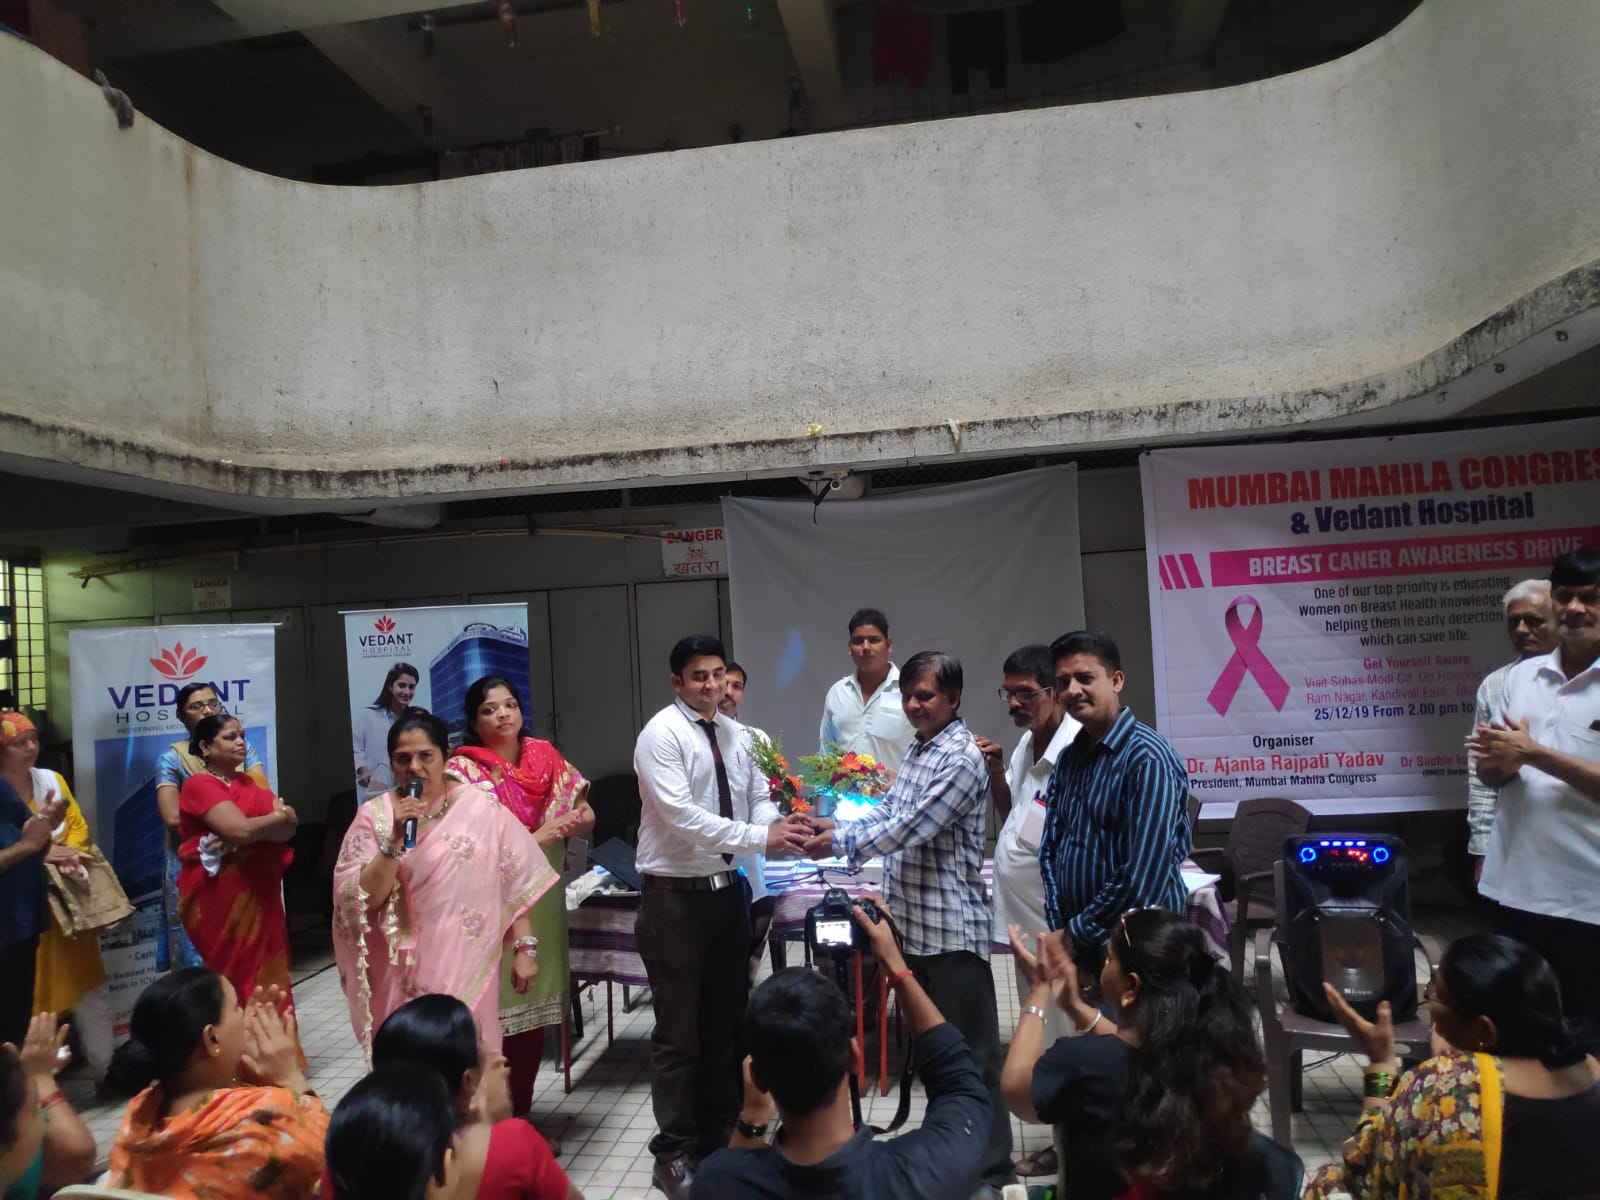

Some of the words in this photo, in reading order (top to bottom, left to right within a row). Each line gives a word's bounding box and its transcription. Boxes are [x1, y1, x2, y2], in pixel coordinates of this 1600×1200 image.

[1187, 469, 1321, 509] MUMBAI
[1329, 461, 1452, 500] MAHILA
[1291, 512, 1310, 534] &
[1314, 502, 1413, 533] Vedant
[1417, 491, 1534, 525] Hospital
[667, 529, 723, 544] DANGER
[1249, 553, 1322, 577] BREAST
[1328, 548, 1391, 572] CANER
[1397, 539, 1518, 568] AWARENESS
[1524, 536, 1583, 559] DRIVE
[673, 560, 720, 575] खतरा
[1314, 587, 1335, 599] One
[1338, 584, 1350, 598] of
[1352, 585, 1370, 597] our
[1374, 583, 1393, 597] top
[1396, 580, 1437, 596] priority
[1440, 579, 1450, 592] is
[1299, 604, 1340, 616] Women
[1343, 603, 1357, 614] on
[1360, 600, 1397, 613] Breast
[1400, 596, 1437, 611] Health
[1325, 618, 1369, 632] helping
[1371, 616, 1400, 629] them
[1417, 613, 1446, 628] early
[1448, 609, 1504, 625] detection
[359, 633, 414, 647] VEDANT
[1360, 632, 1394, 646] which
[1397, 632, 1417, 645] can
[1420, 631, 1445, 643] save
[1363, 657, 1382, 670] Get
[1387, 655, 1431, 669] Yourself
[1435, 655, 1471, 665] Aware
[1305, 676, 1328, 688] Visit
[107, 679, 251, 710] VEDNT
[1307, 692, 1331, 704] Ram
[1314, 705, 1369, 720] 25/12/19
[1373, 705, 1404, 718] From
[1408, 702, 1435, 716] 2.00
[1440, 703, 1458, 717] pm
[1462, 701, 1474, 713] to
[1252, 734, 1314, 750] Organiser
[1187, 758, 1208, 774] Dr.
[1214, 756, 1265, 775] Ajanta
[1271, 753, 1329, 773] Rajpati
[1334, 751, 1384, 769] Yadav
[1401, 756, 1413, 768] Dr
[1191, 778, 1242, 789] President,
[1245, 775, 1287, 787] Mumbai
[1290, 774, 1325, 785] Mahila
[1328, 773, 1377, 785] Congress
